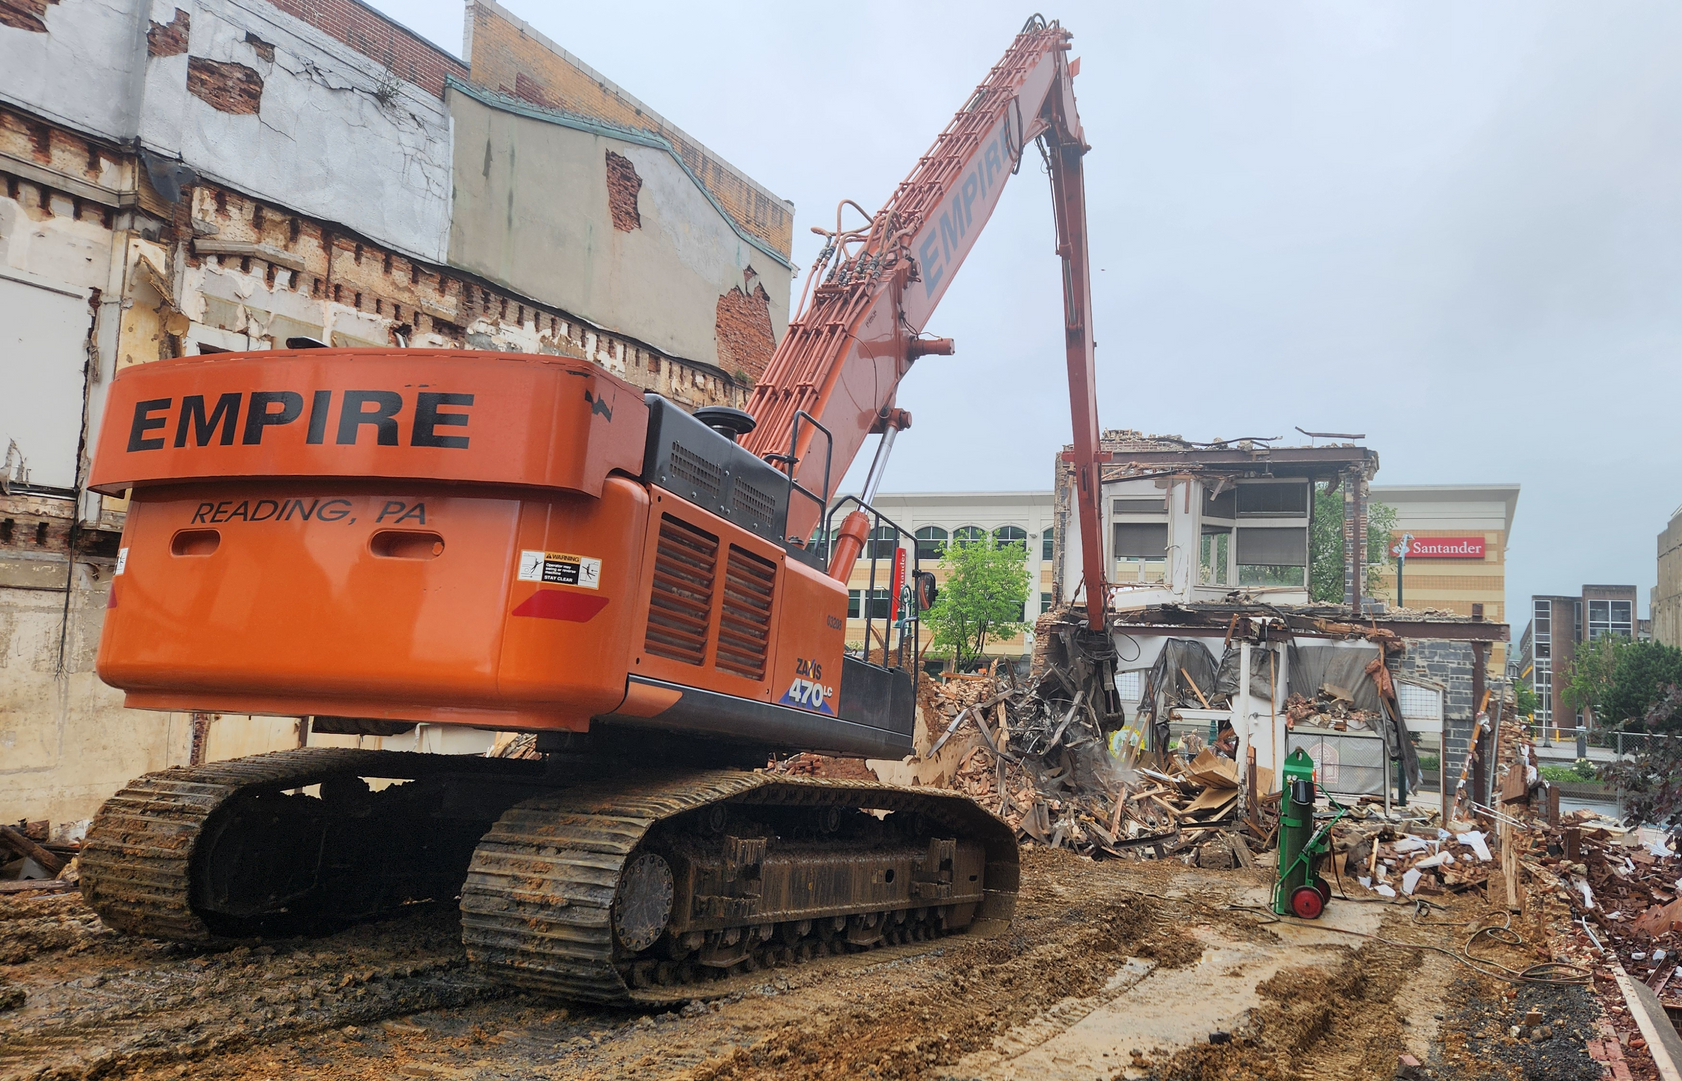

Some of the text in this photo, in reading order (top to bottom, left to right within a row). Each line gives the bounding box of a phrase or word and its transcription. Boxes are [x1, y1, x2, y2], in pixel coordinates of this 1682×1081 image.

[918, 117, 1012, 300] EMPIRE
[126, 390, 475, 453] EMPIRE
[190, 499, 426, 525] READING, PA
[552, 554, 580, 562] WARNING
[1412, 541, 1482, 554] Santander
[795, 657, 822, 680] ZAXIS
[788, 677, 824, 708] 470
